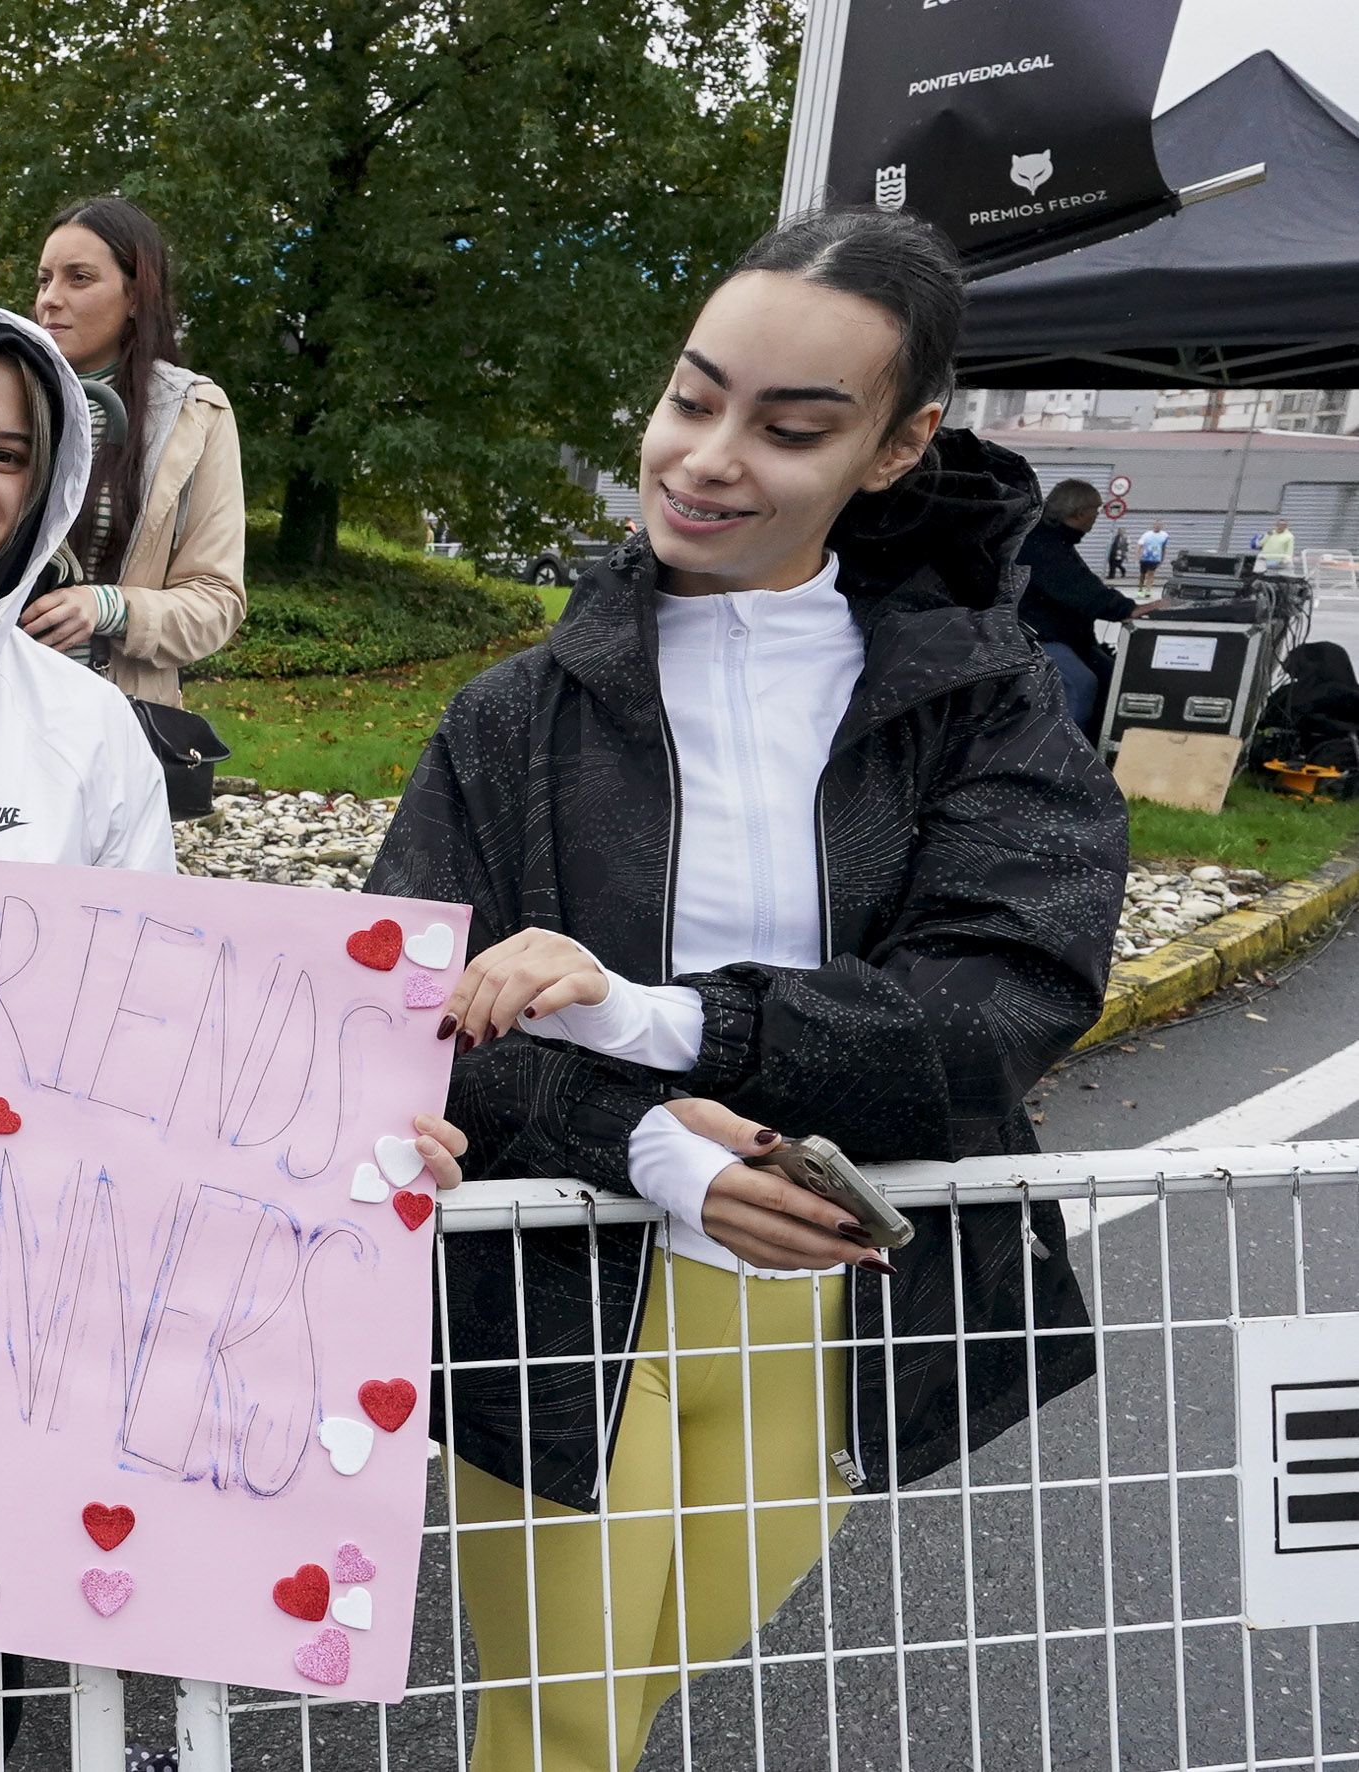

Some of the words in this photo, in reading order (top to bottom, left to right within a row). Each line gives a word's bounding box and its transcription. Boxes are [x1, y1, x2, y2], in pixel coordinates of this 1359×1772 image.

[908, 54, 1054, 97] PONTEVEDRA.GAL
[969, 203, 1044, 225] PREMIOS
[1048, 189, 1108, 212] FEROZ
